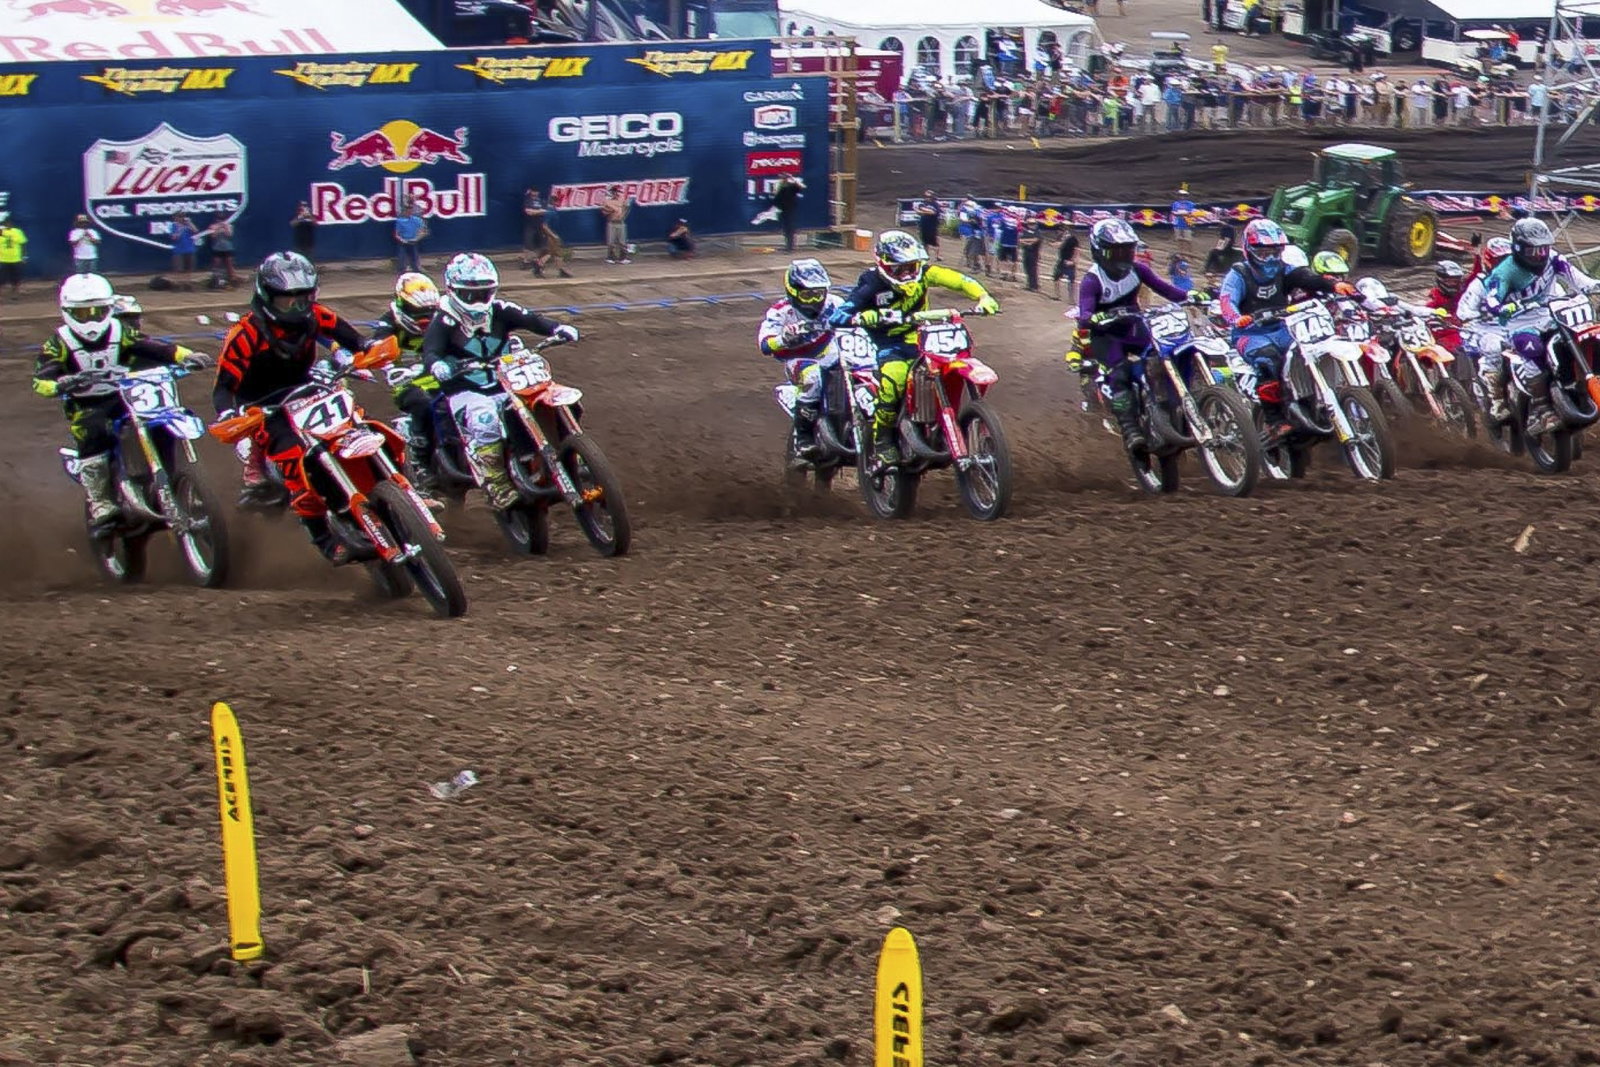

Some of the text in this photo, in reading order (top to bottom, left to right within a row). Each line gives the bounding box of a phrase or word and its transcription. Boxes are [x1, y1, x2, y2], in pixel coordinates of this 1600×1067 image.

[0, 28, 337, 61] Red Bull
[549, 112, 683, 142] GEICO
[578, 137, 684, 157] Motorcycle
[107, 163, 235, 195] LUCAS
[312, 173, 487, 225] Red Bull
[303, 394, 350, 430] 41
[892, 982, 910, 1067] ERBIS
